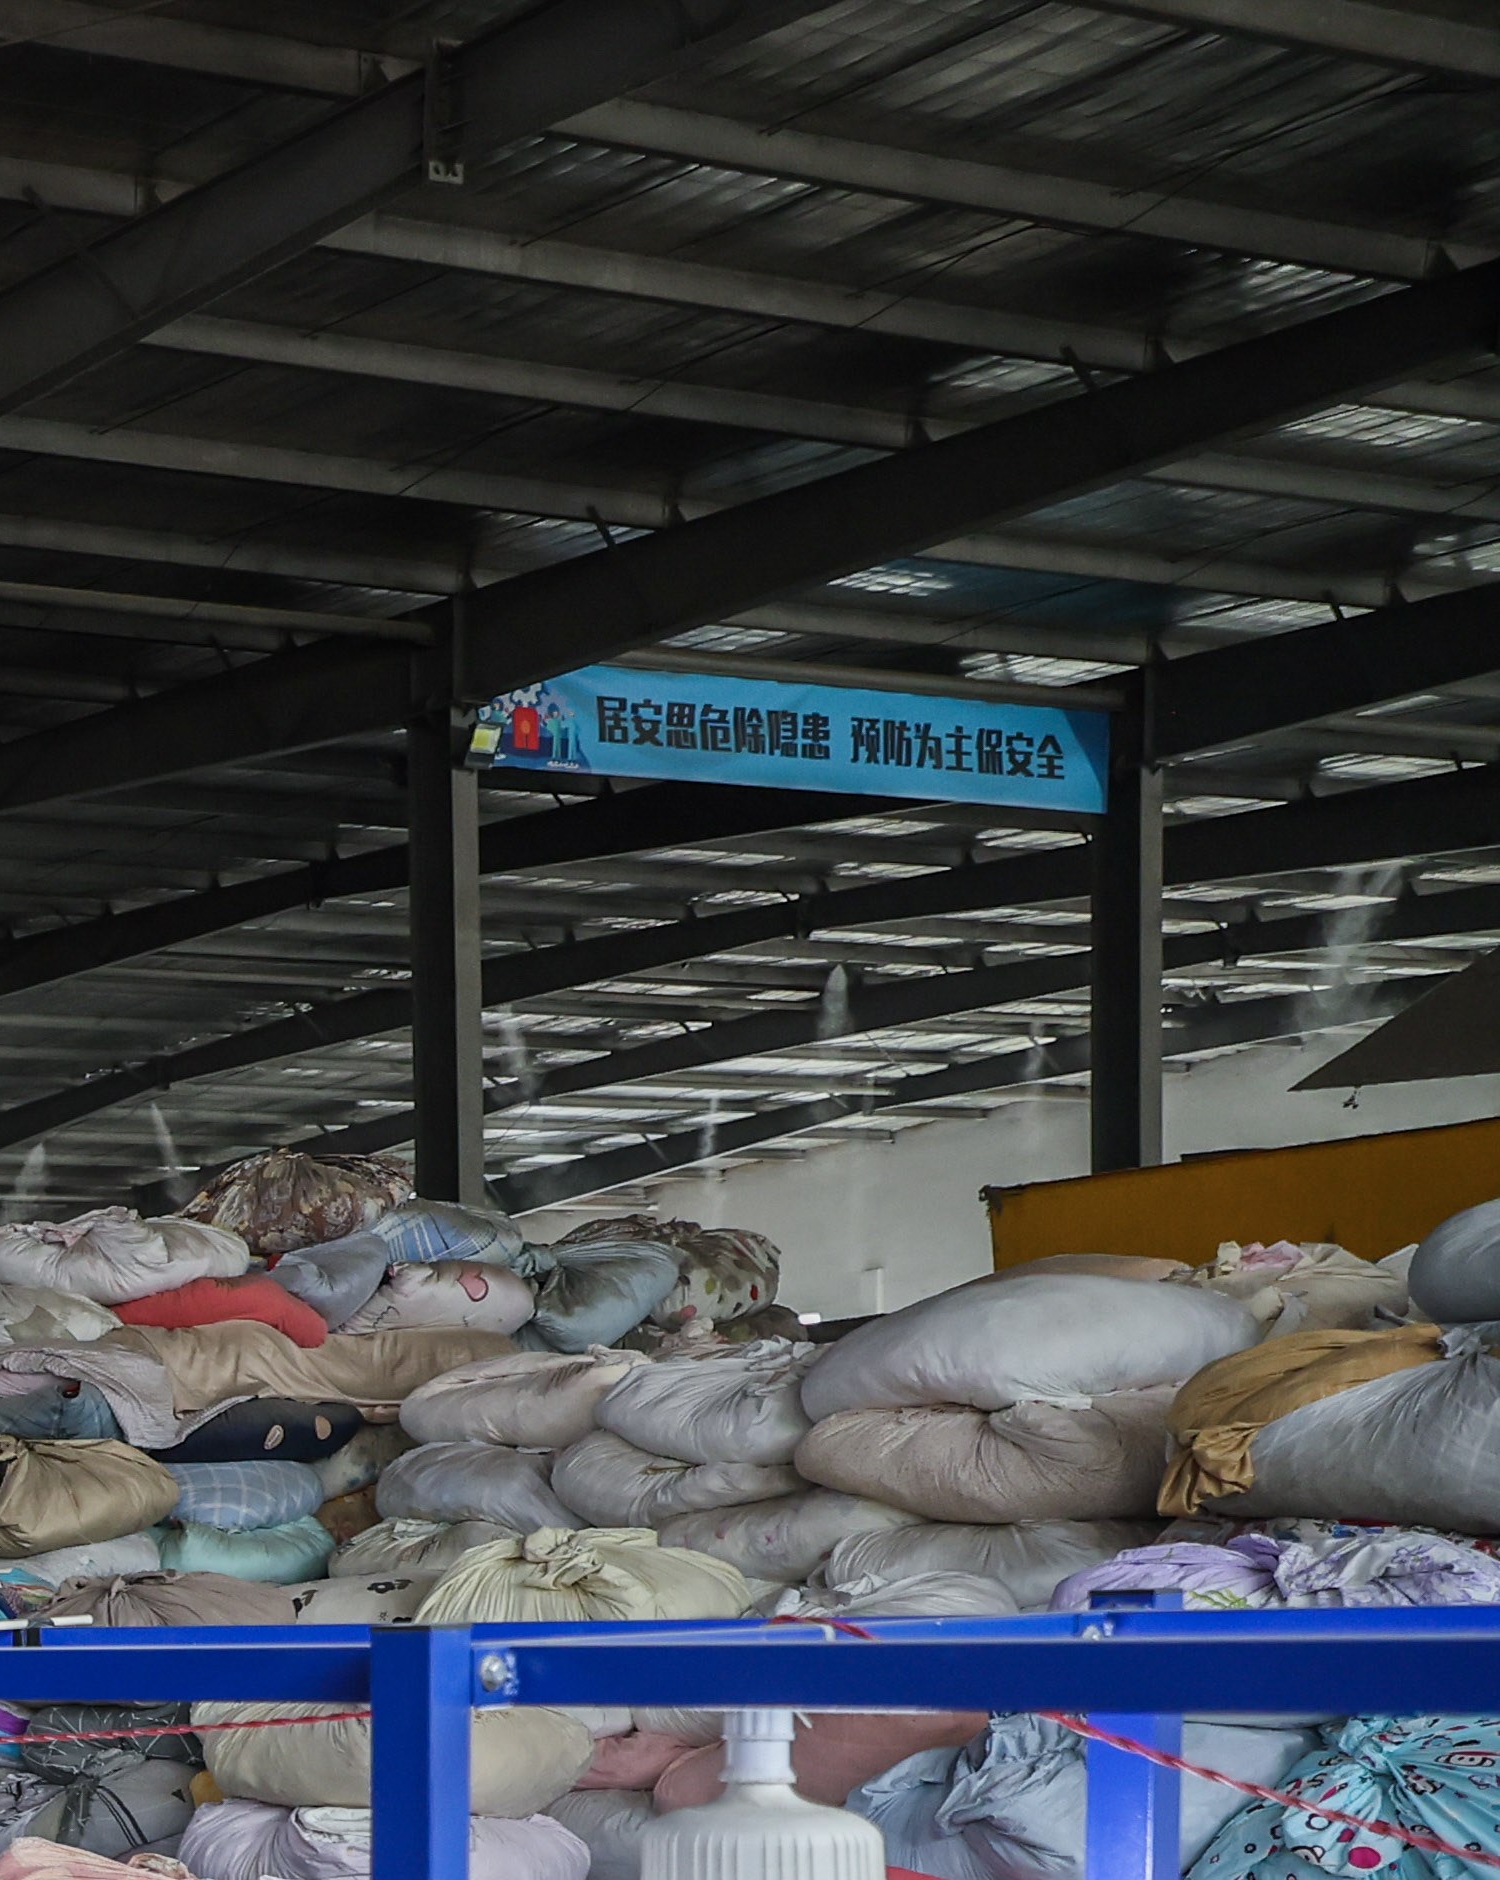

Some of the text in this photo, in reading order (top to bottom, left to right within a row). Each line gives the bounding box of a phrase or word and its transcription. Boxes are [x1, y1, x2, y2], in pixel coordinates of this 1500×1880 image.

[596, 695, 1065, 779] 居安思危除隐患 预防为主保安全
